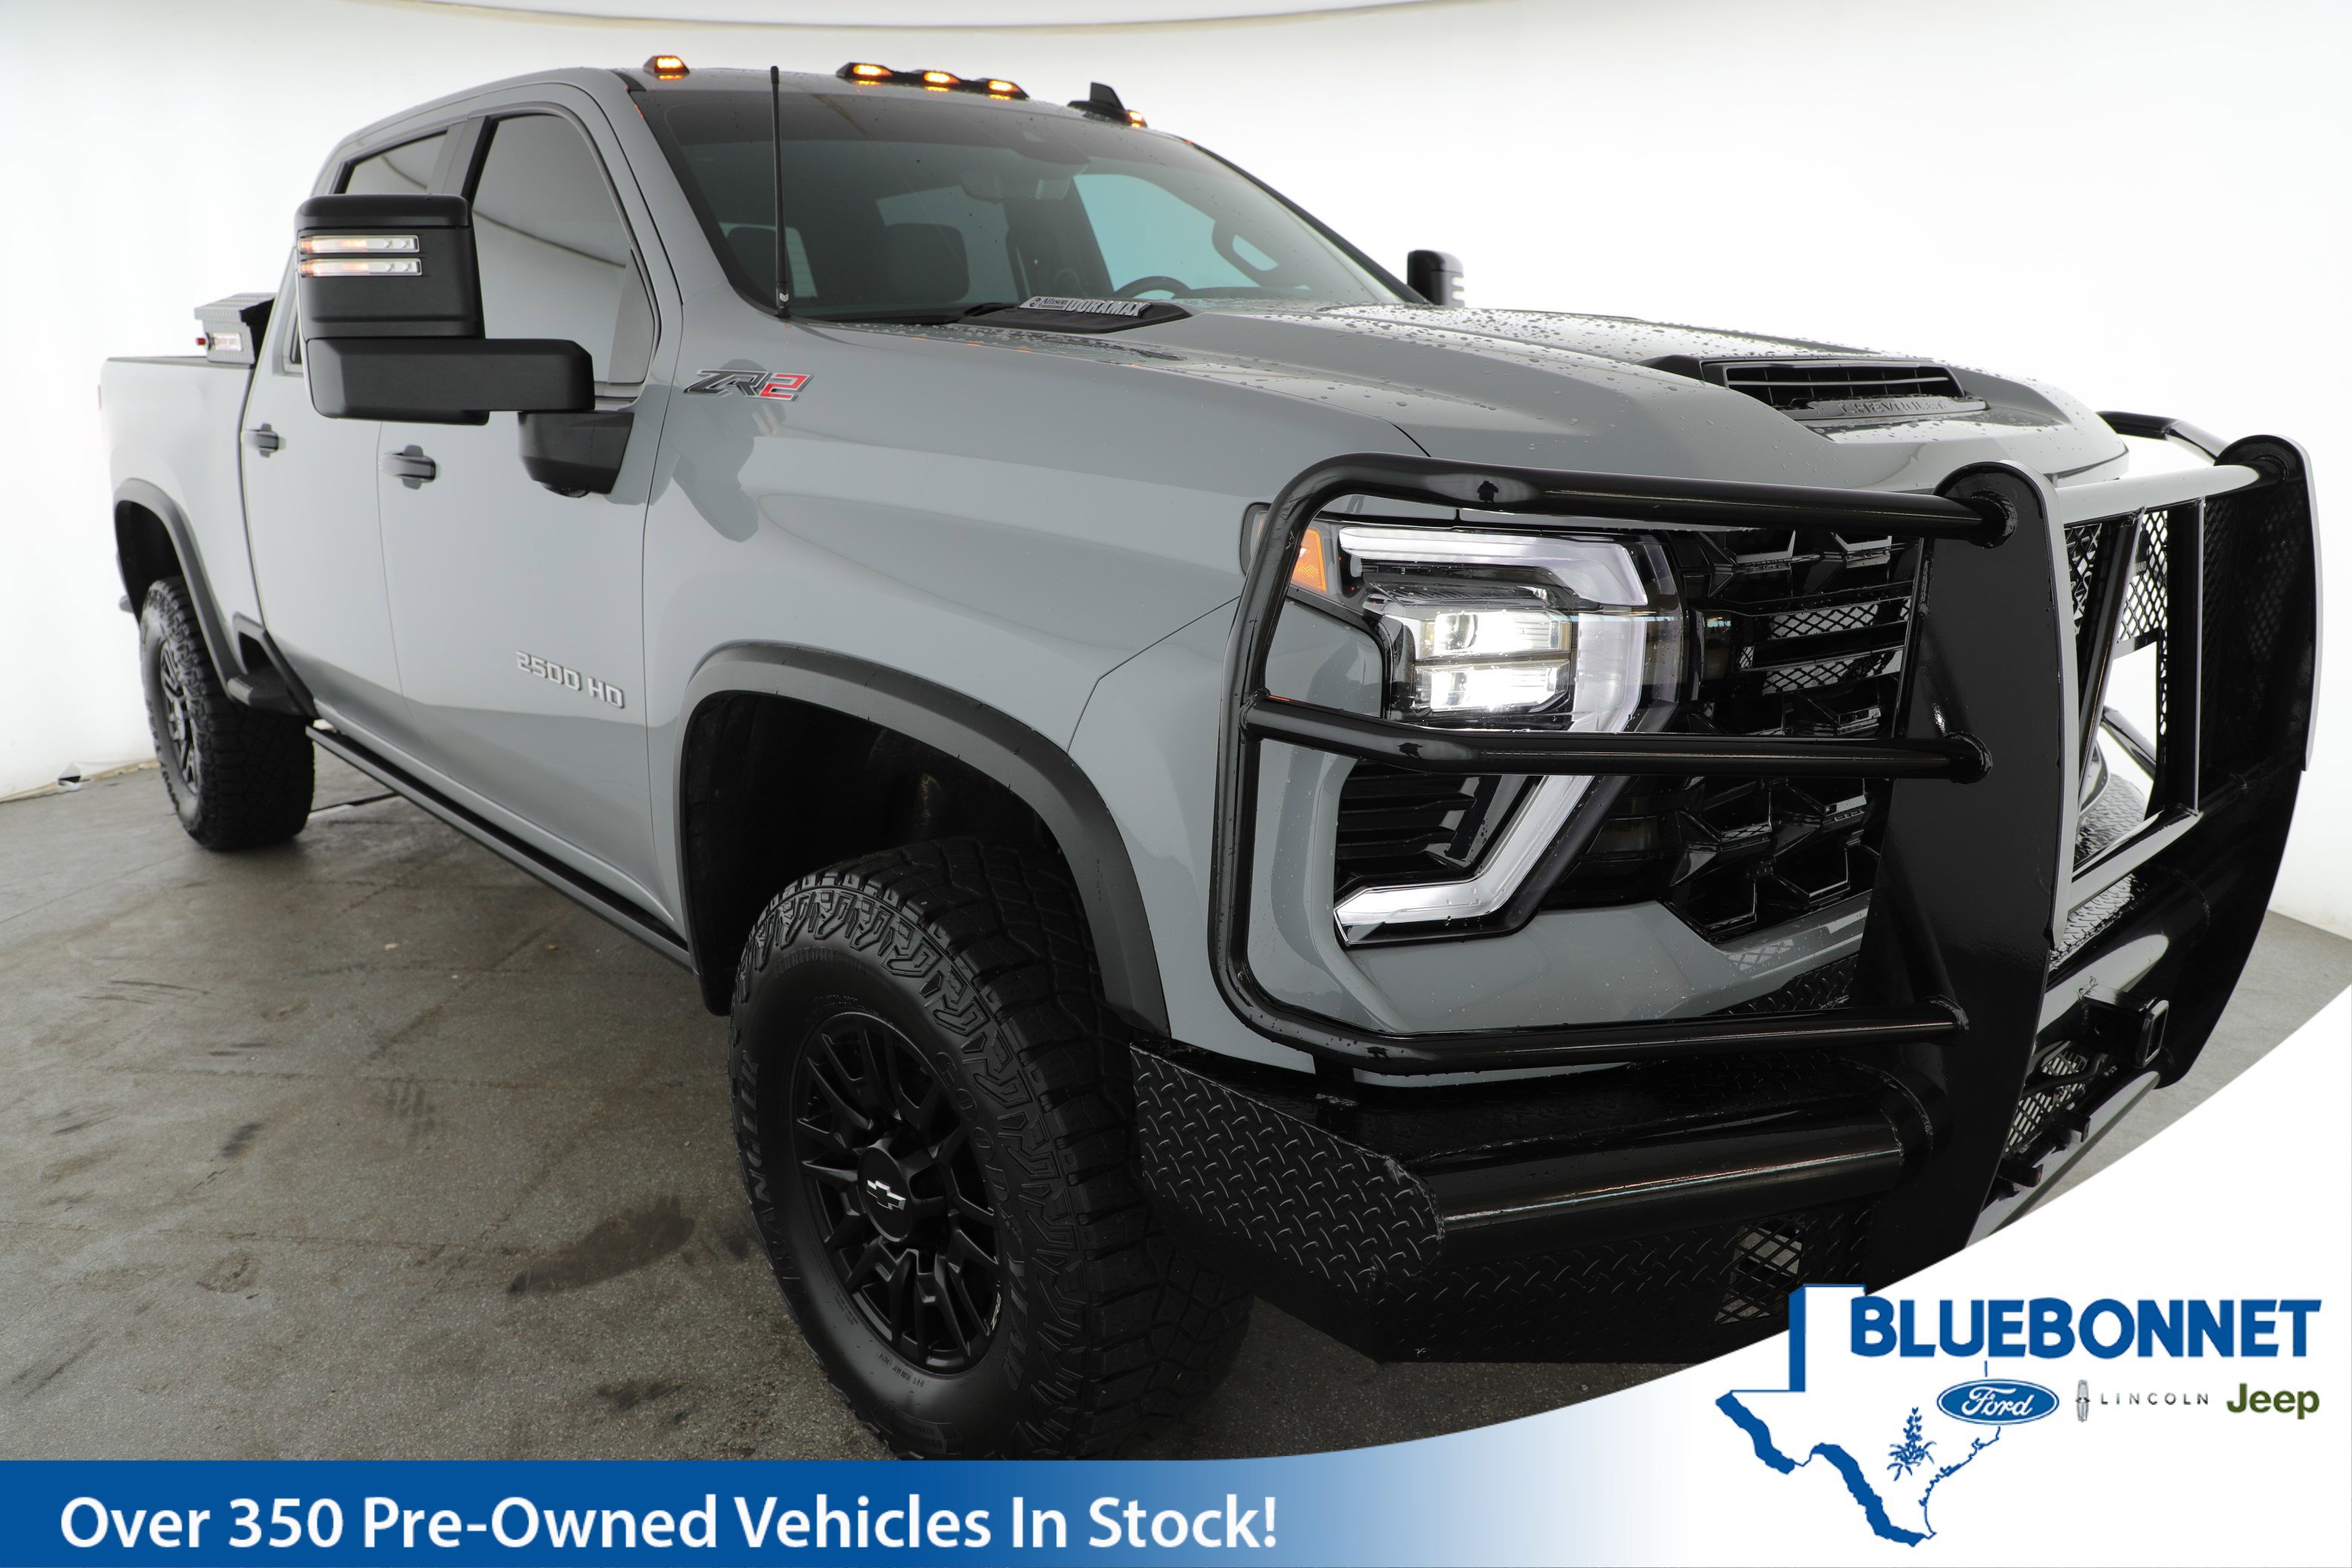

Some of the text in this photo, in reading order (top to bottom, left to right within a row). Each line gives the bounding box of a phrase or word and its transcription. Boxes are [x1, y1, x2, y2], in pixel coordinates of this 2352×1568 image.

[1065, 298, 1151, 317] DURAMAX
[683, 369, 813, 402] ZR2
[516, 651, 625, 709] 2500 HD
